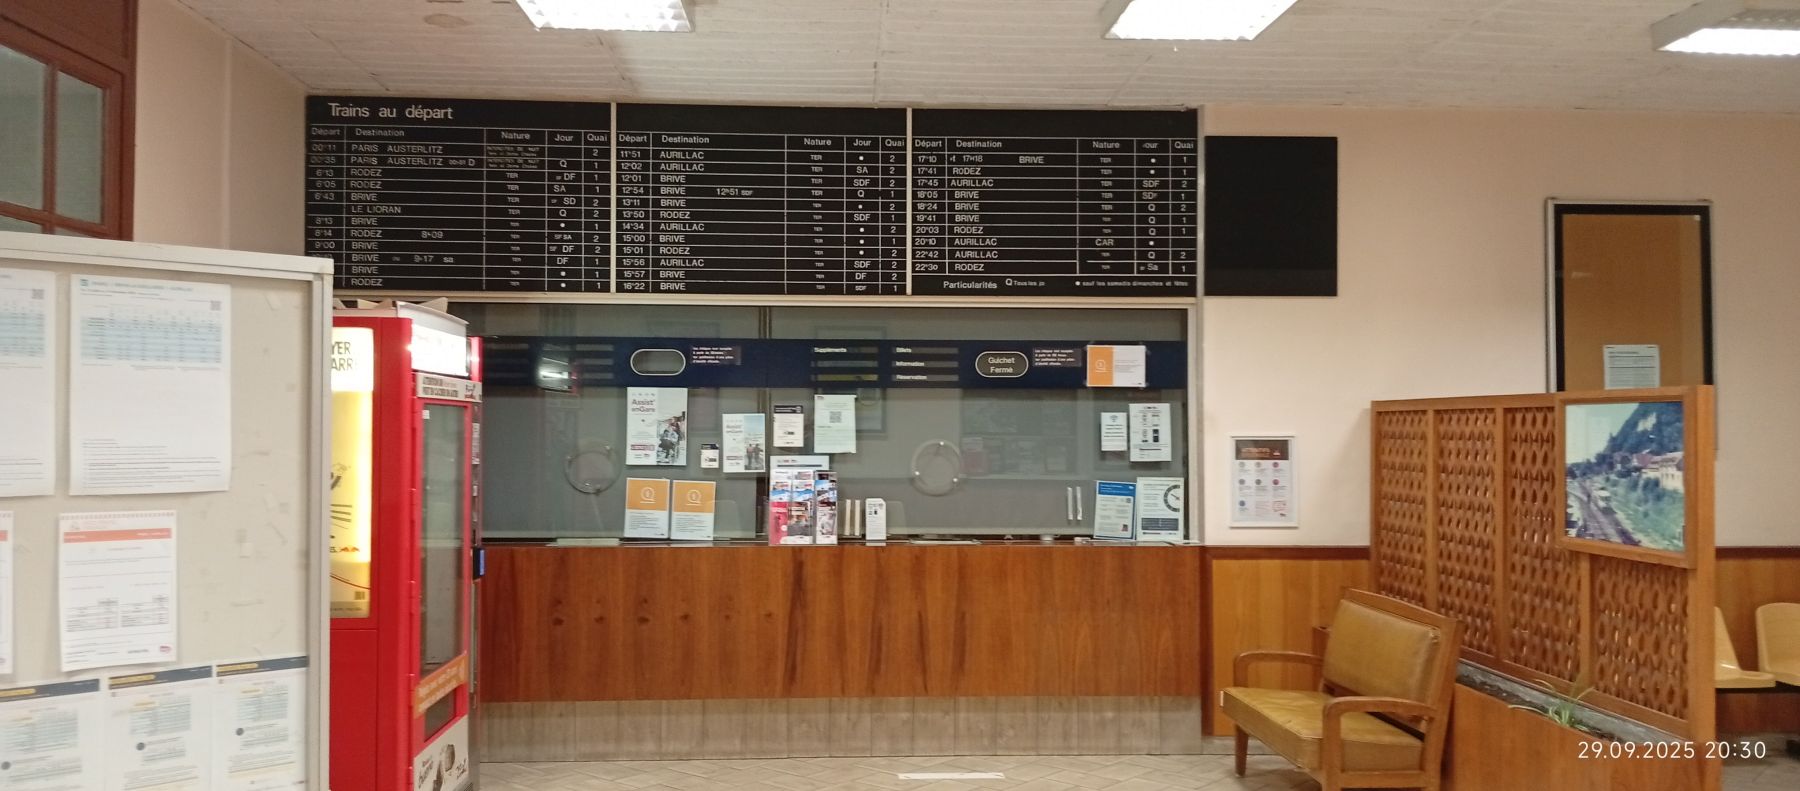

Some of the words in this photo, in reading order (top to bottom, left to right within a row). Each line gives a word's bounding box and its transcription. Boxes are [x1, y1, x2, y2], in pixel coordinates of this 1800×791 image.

[328, 102, 370, 117] Trains
[378, 108, 396, 118] au
[406, 105, 454, 121] départ
[356, 128, 404, 136] Destination
[501, 132, 530, 140] Nature
[587, 134, 608, 142] Quai
[619, 134, 648, 142] Départ
[662, 135, 710, 144] Destination
[885, 139, 904, 147] Quai
[956, 140, 1002, 148] Destination
[387, 144, 443, 154] AUSTERLITZ
[351, 156, 378, 164] PARIS
[388, 157, 443, 166] AUSTERLITZ
[563, 198, 576, 206] SD
[559, 209, 566, 217] Q
[351, 230, 382, 238] RODEZ
[352, 242, 378, 250] BRIVE
[660, 246, 690, 254] RODEZ
[660, 259, 704, 267] AURILLAC
[351, 278, 383, 286] RODEZ
[944, 281, 998, 289] Particularités
